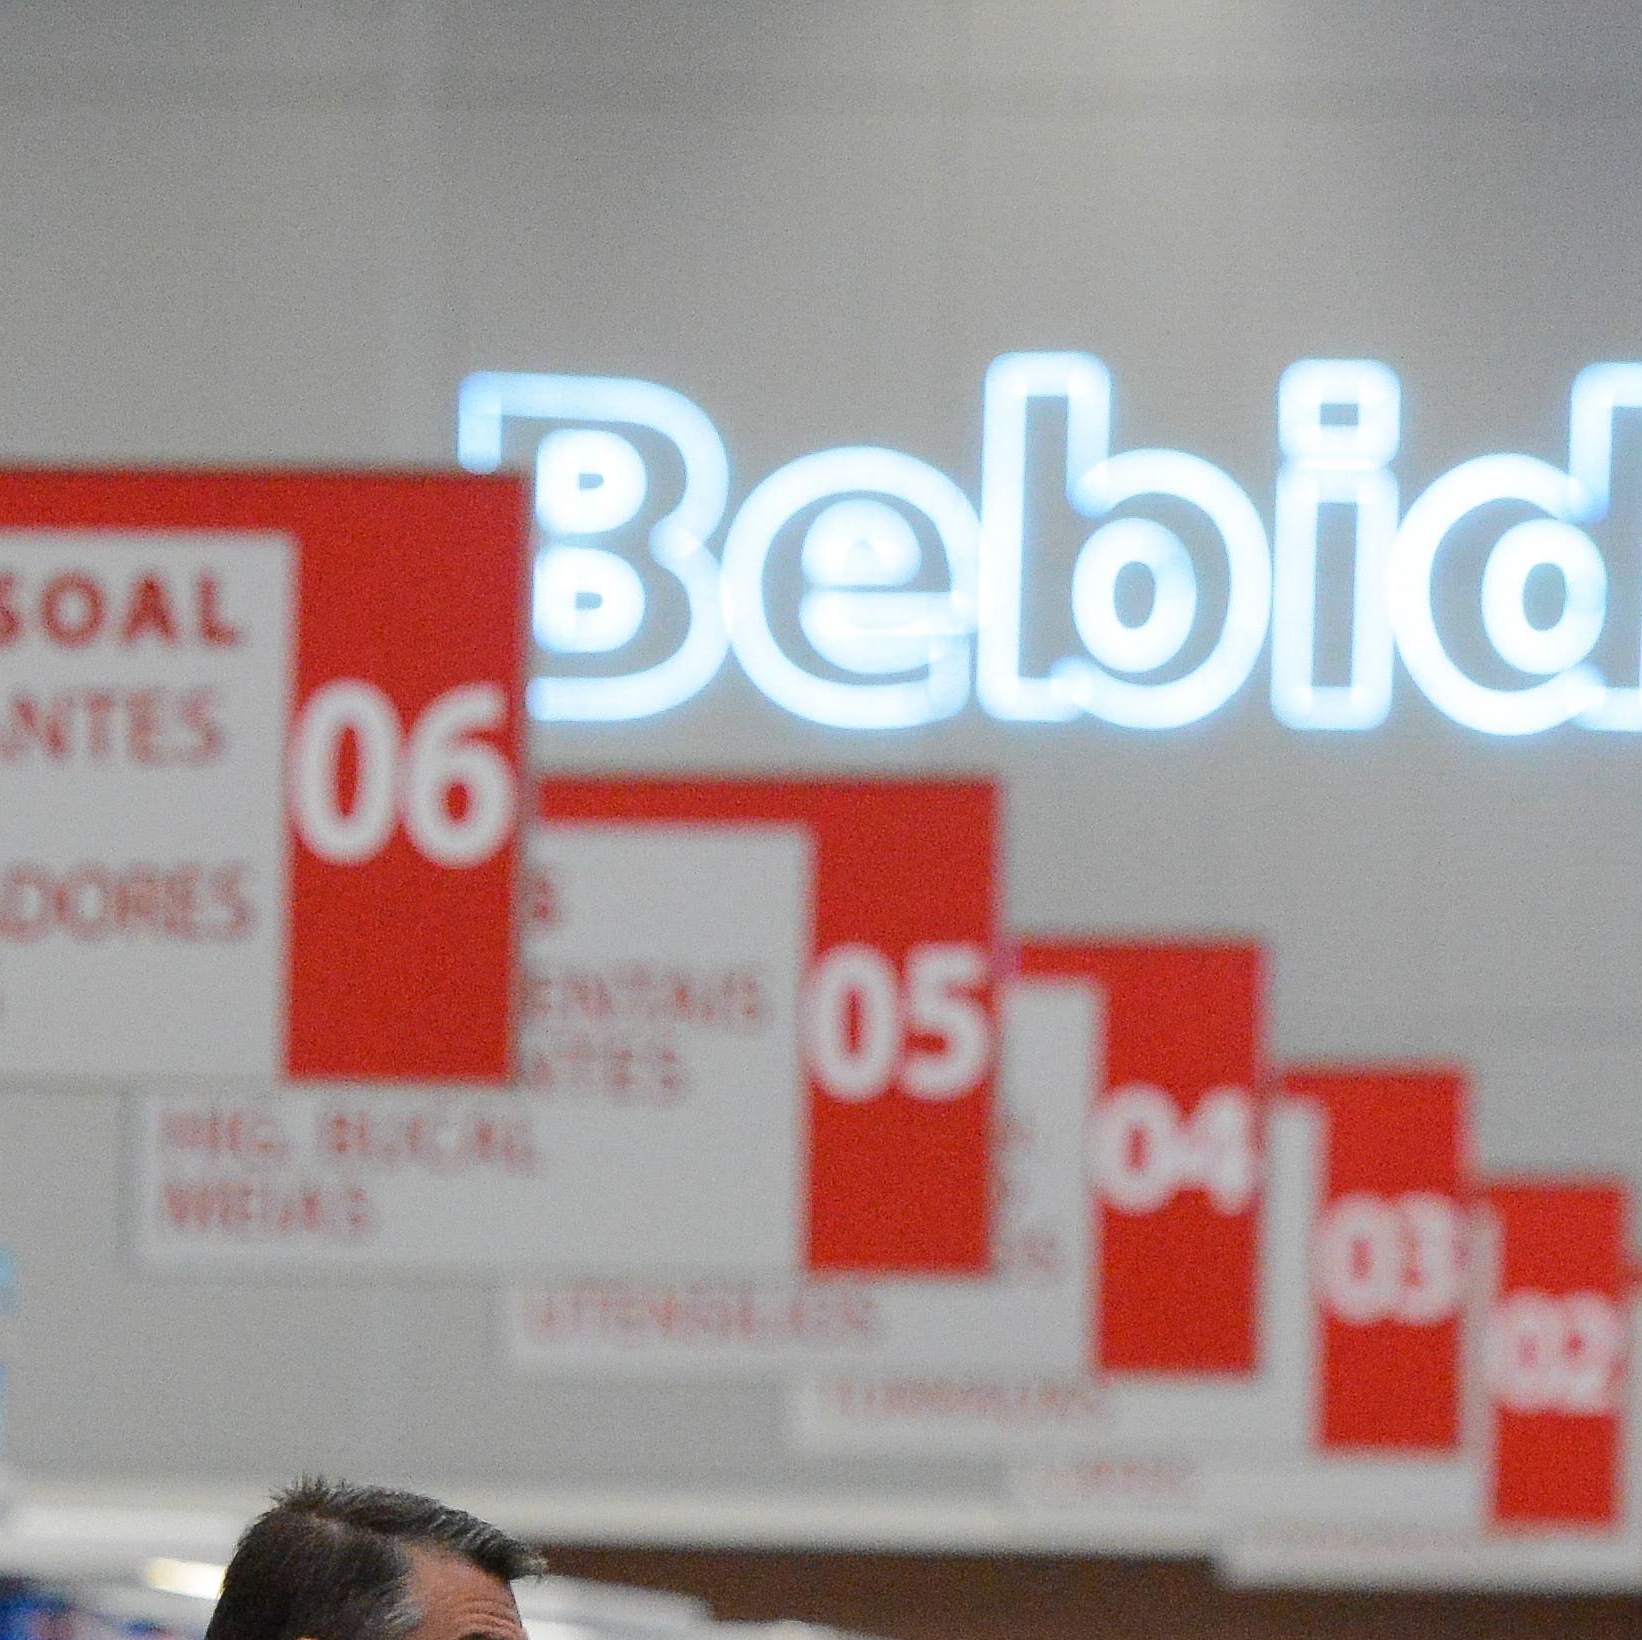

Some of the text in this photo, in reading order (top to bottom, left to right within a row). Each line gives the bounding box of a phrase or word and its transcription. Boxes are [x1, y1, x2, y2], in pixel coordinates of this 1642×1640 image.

[293, 678, 517, 866] 06
[804, 943, 993, 1102] 05
[1091, 1086, 1255, 1212] 04
[1321, 1192, 1463, 1324] 03
[1491, 1292, 1625, 1412] 02
